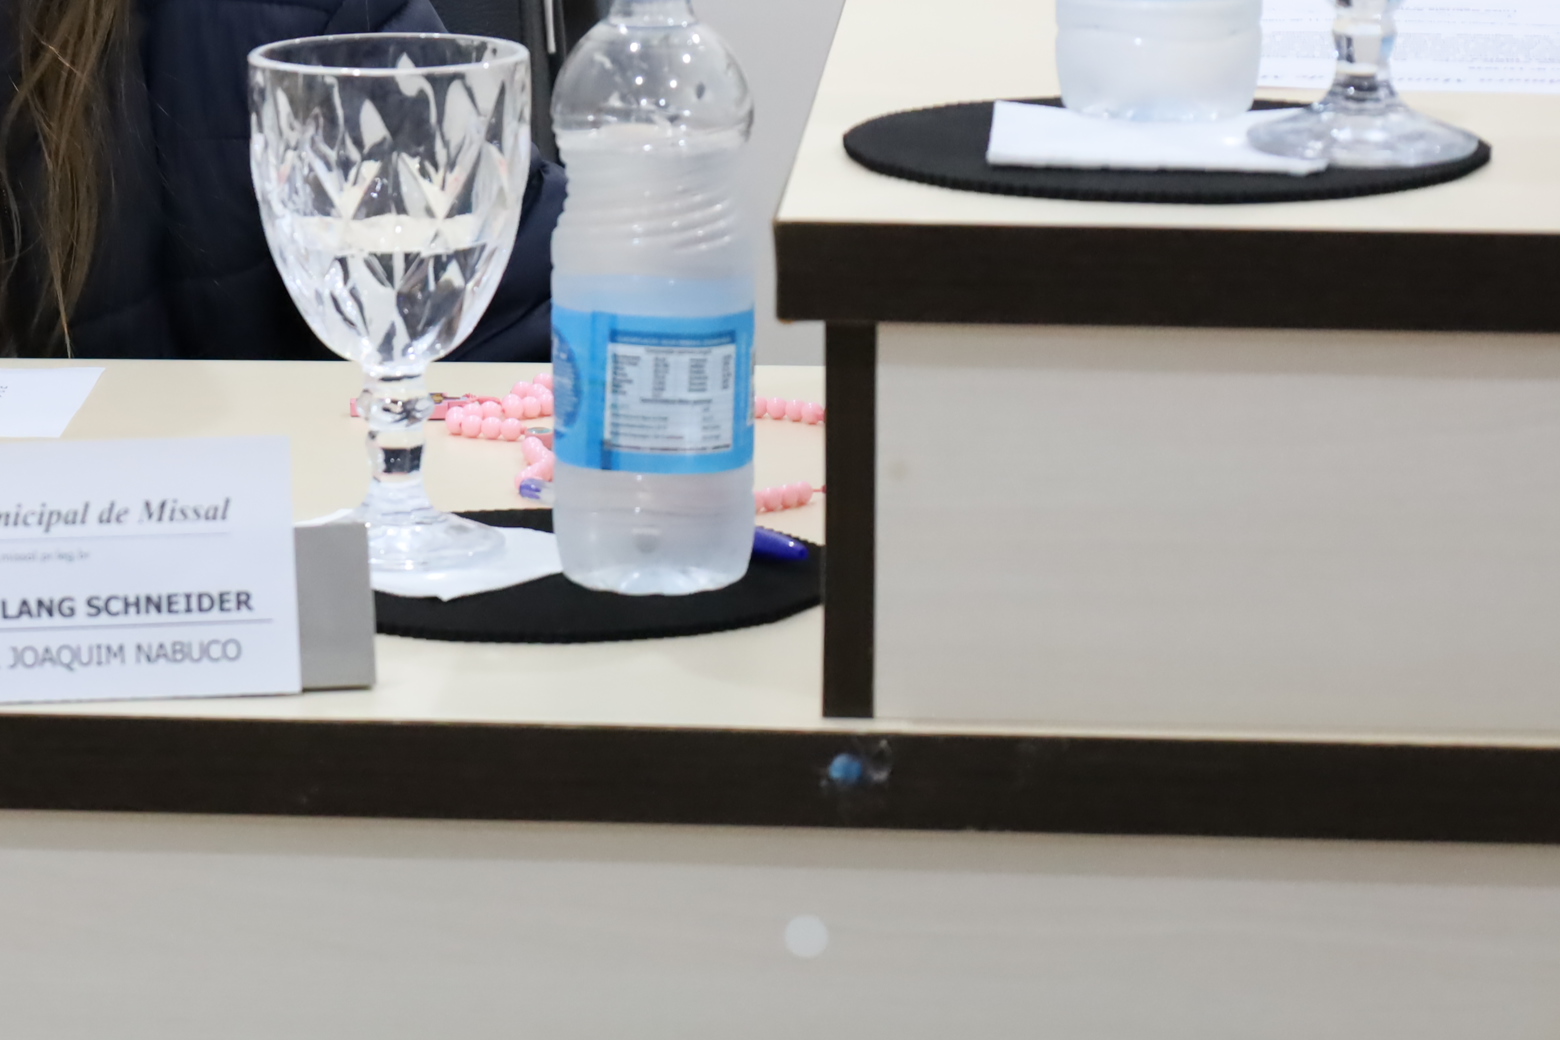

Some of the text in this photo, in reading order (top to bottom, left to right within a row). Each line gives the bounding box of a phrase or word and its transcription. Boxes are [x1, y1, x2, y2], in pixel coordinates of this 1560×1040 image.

[98, 500, 130, 526] de
[142, 496, 232, 525] Missal
[0, 596, 77, 620] LANG
[85, 590, 254, 618] SCHNEIDER
[9, 643, 126, 672] JOAQUIM
[135, 638, 244, 664] NABUCO
